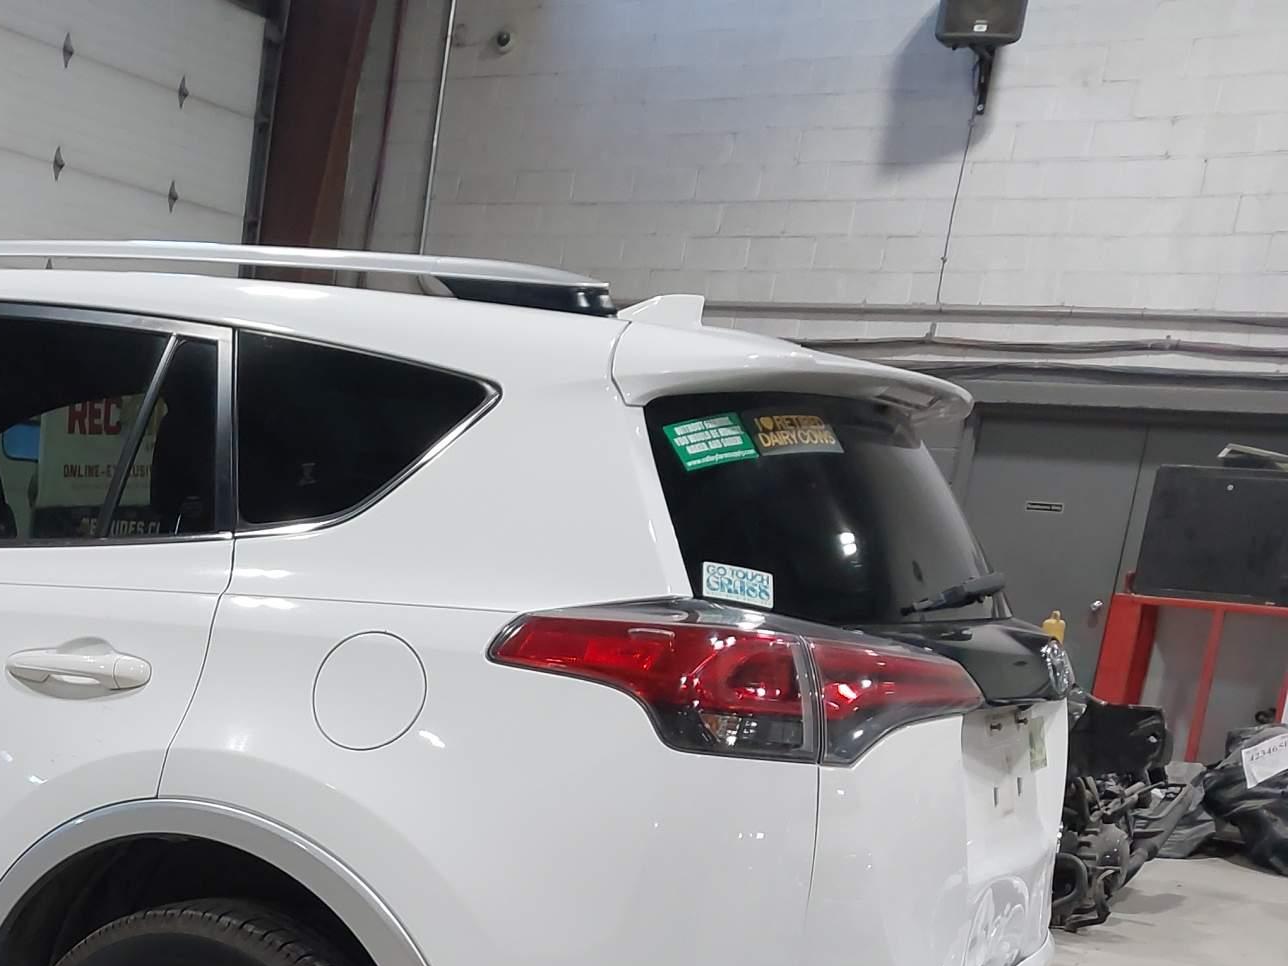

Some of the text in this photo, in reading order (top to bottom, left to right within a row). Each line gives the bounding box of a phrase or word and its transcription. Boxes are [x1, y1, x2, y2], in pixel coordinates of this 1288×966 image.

[68, 398, 121, 435] REC
[758, 431, 799, 448] DAIRY
[798, 430, 836, 445] COWS
[706, 564, 770, 585] GO TOUCH
